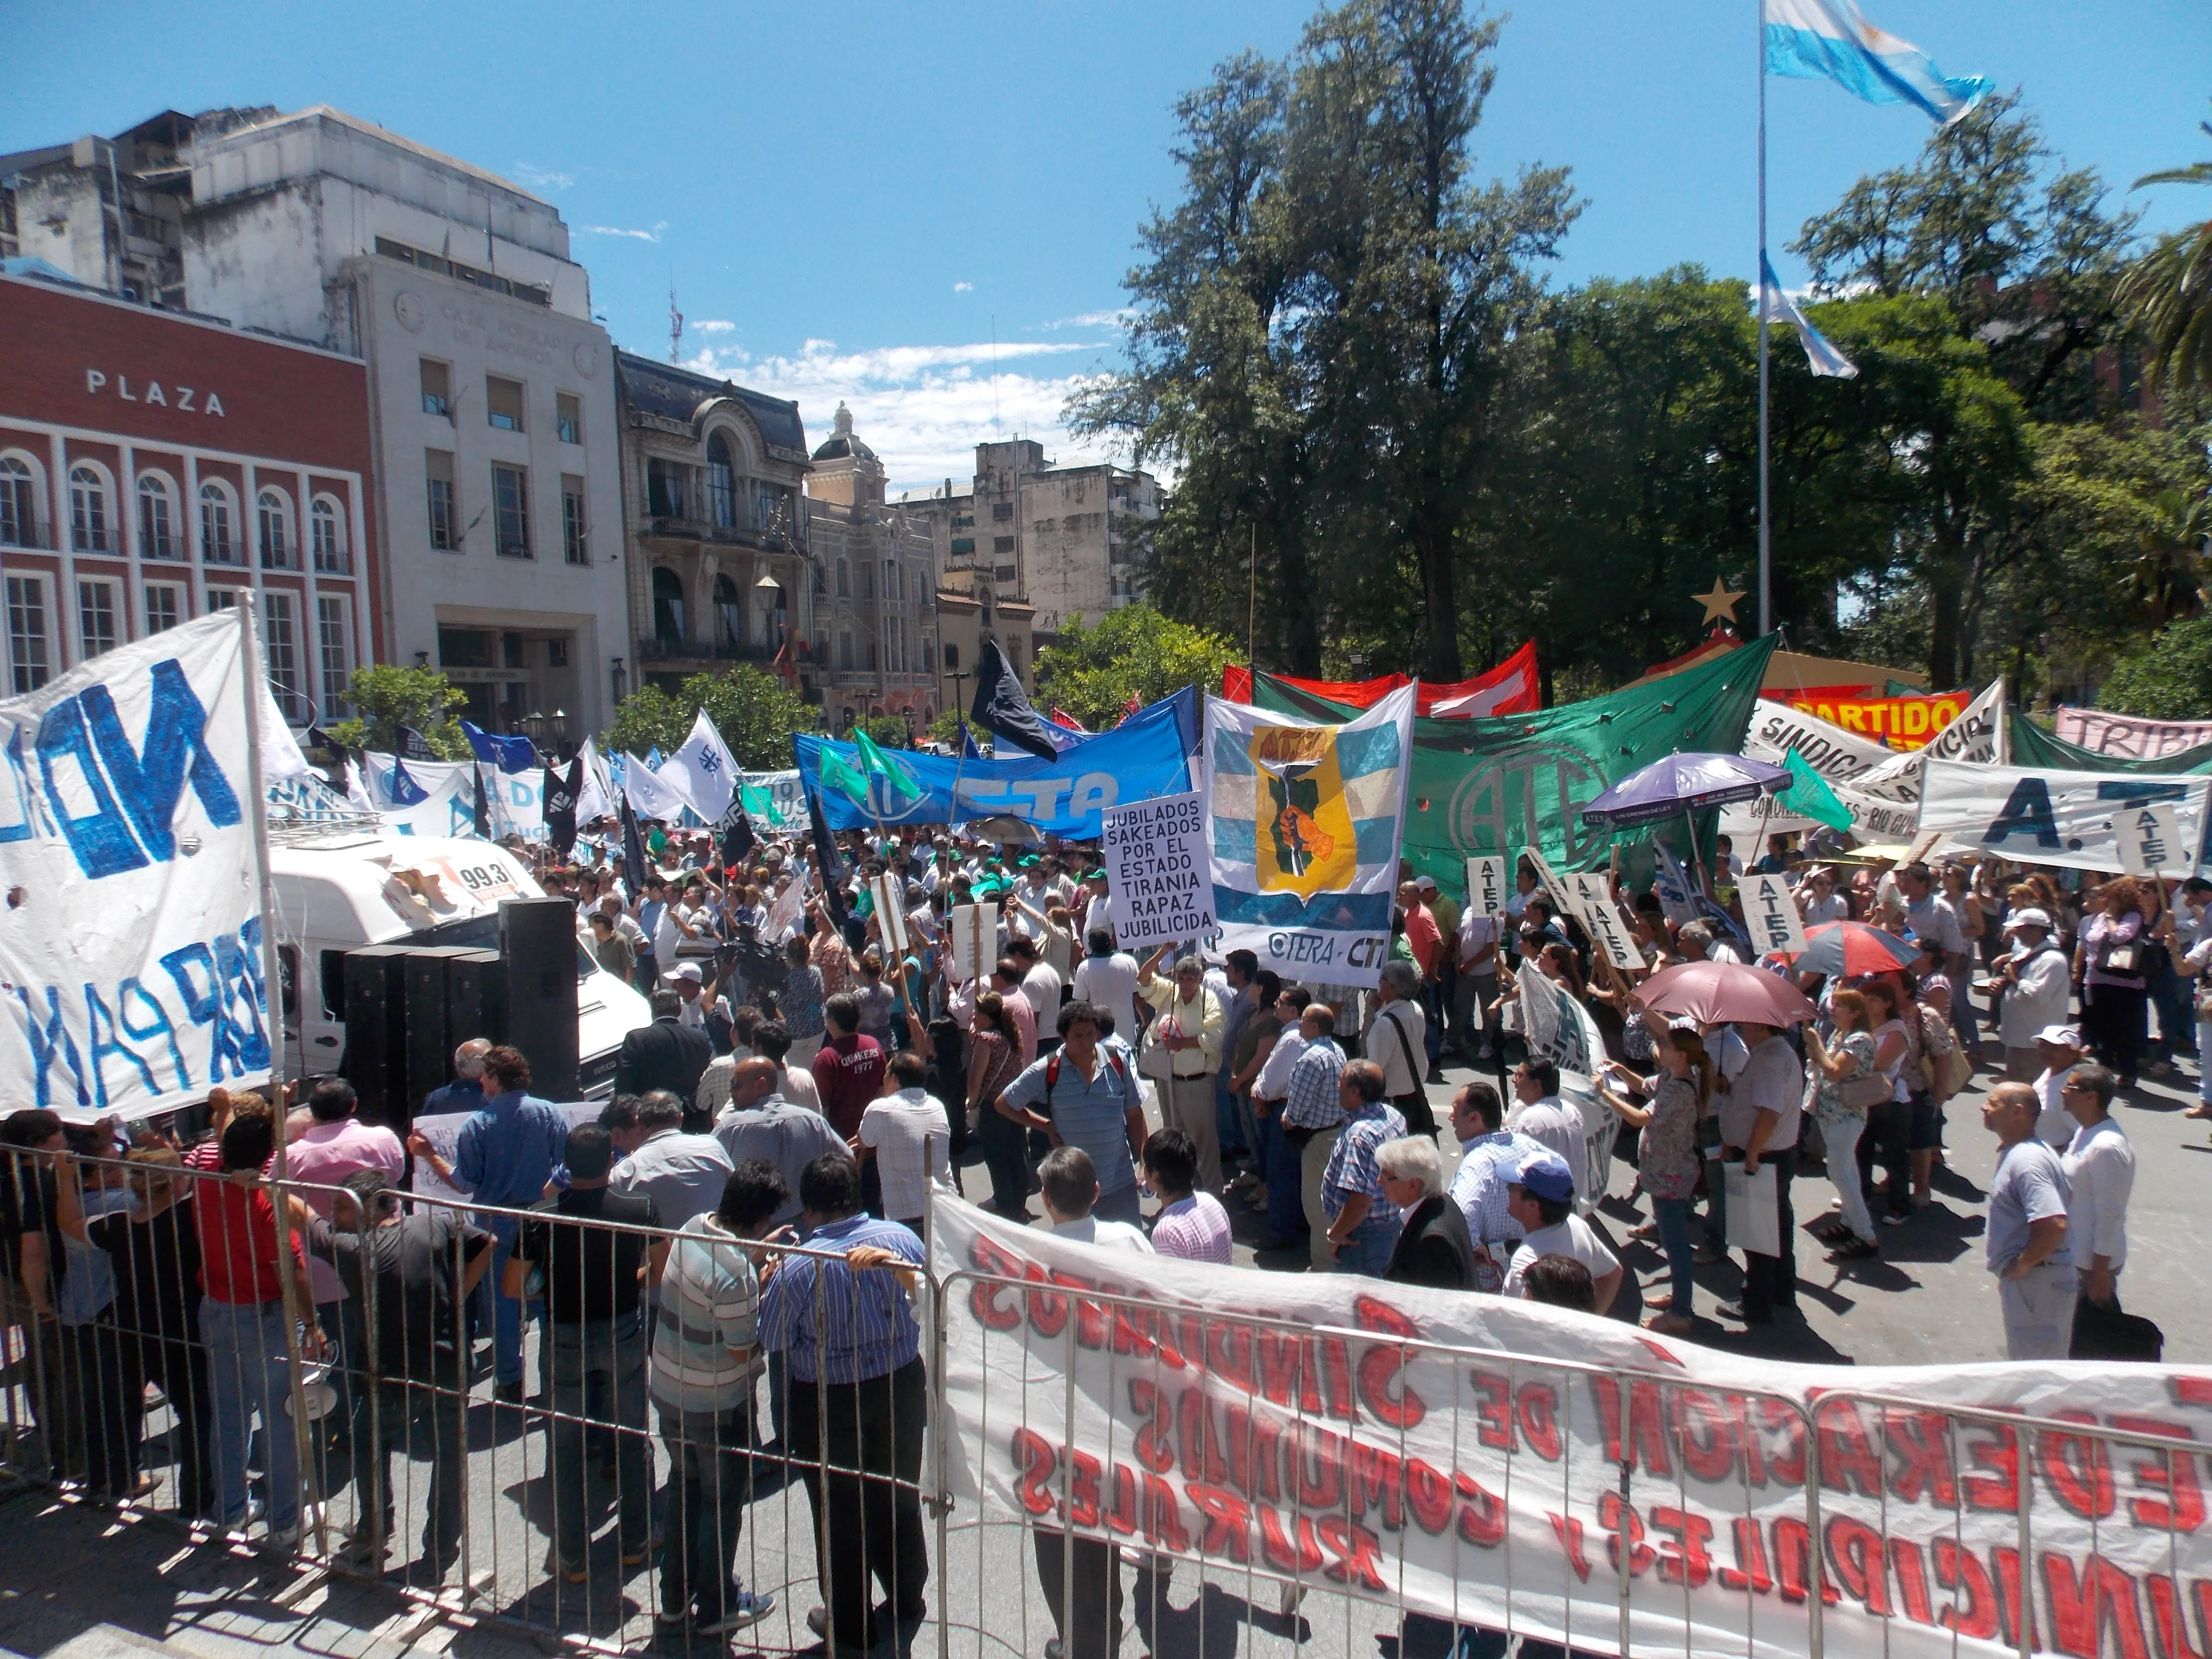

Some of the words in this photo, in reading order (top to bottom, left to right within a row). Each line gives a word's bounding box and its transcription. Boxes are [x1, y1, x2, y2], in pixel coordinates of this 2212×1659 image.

[86, 369, 226, 418] PLAZA
[1106, 800, 1199, 829] JUBILADOS
[1107, 817, 1200, 845] SAKEADOS
[2135, 811, 2167, 869] ATEP
[1122, 842, 1155, 861] POR
[1167, 837, 1189, 854] EL
[460, 863, 510, 890] 99.3
[1120, 854, 1191, 878] ESTADO
[1121, 872, 1201, 898] TIRANIA
[1480, 860, 1498, 914] ATEP
[1131, 892, 1195, 918] RAPAZ
[1759, 879, 1790, 949] ATEP
[1119, 911, 1213, 939] JUBILICIDA
[1595, 904, 1628, 965] ATEP
[1268, 932, 1334, 965] CTERA
[841, 1048, 879, 1067] QUAKERS
[854, 1060, 873, 1075] 1977
